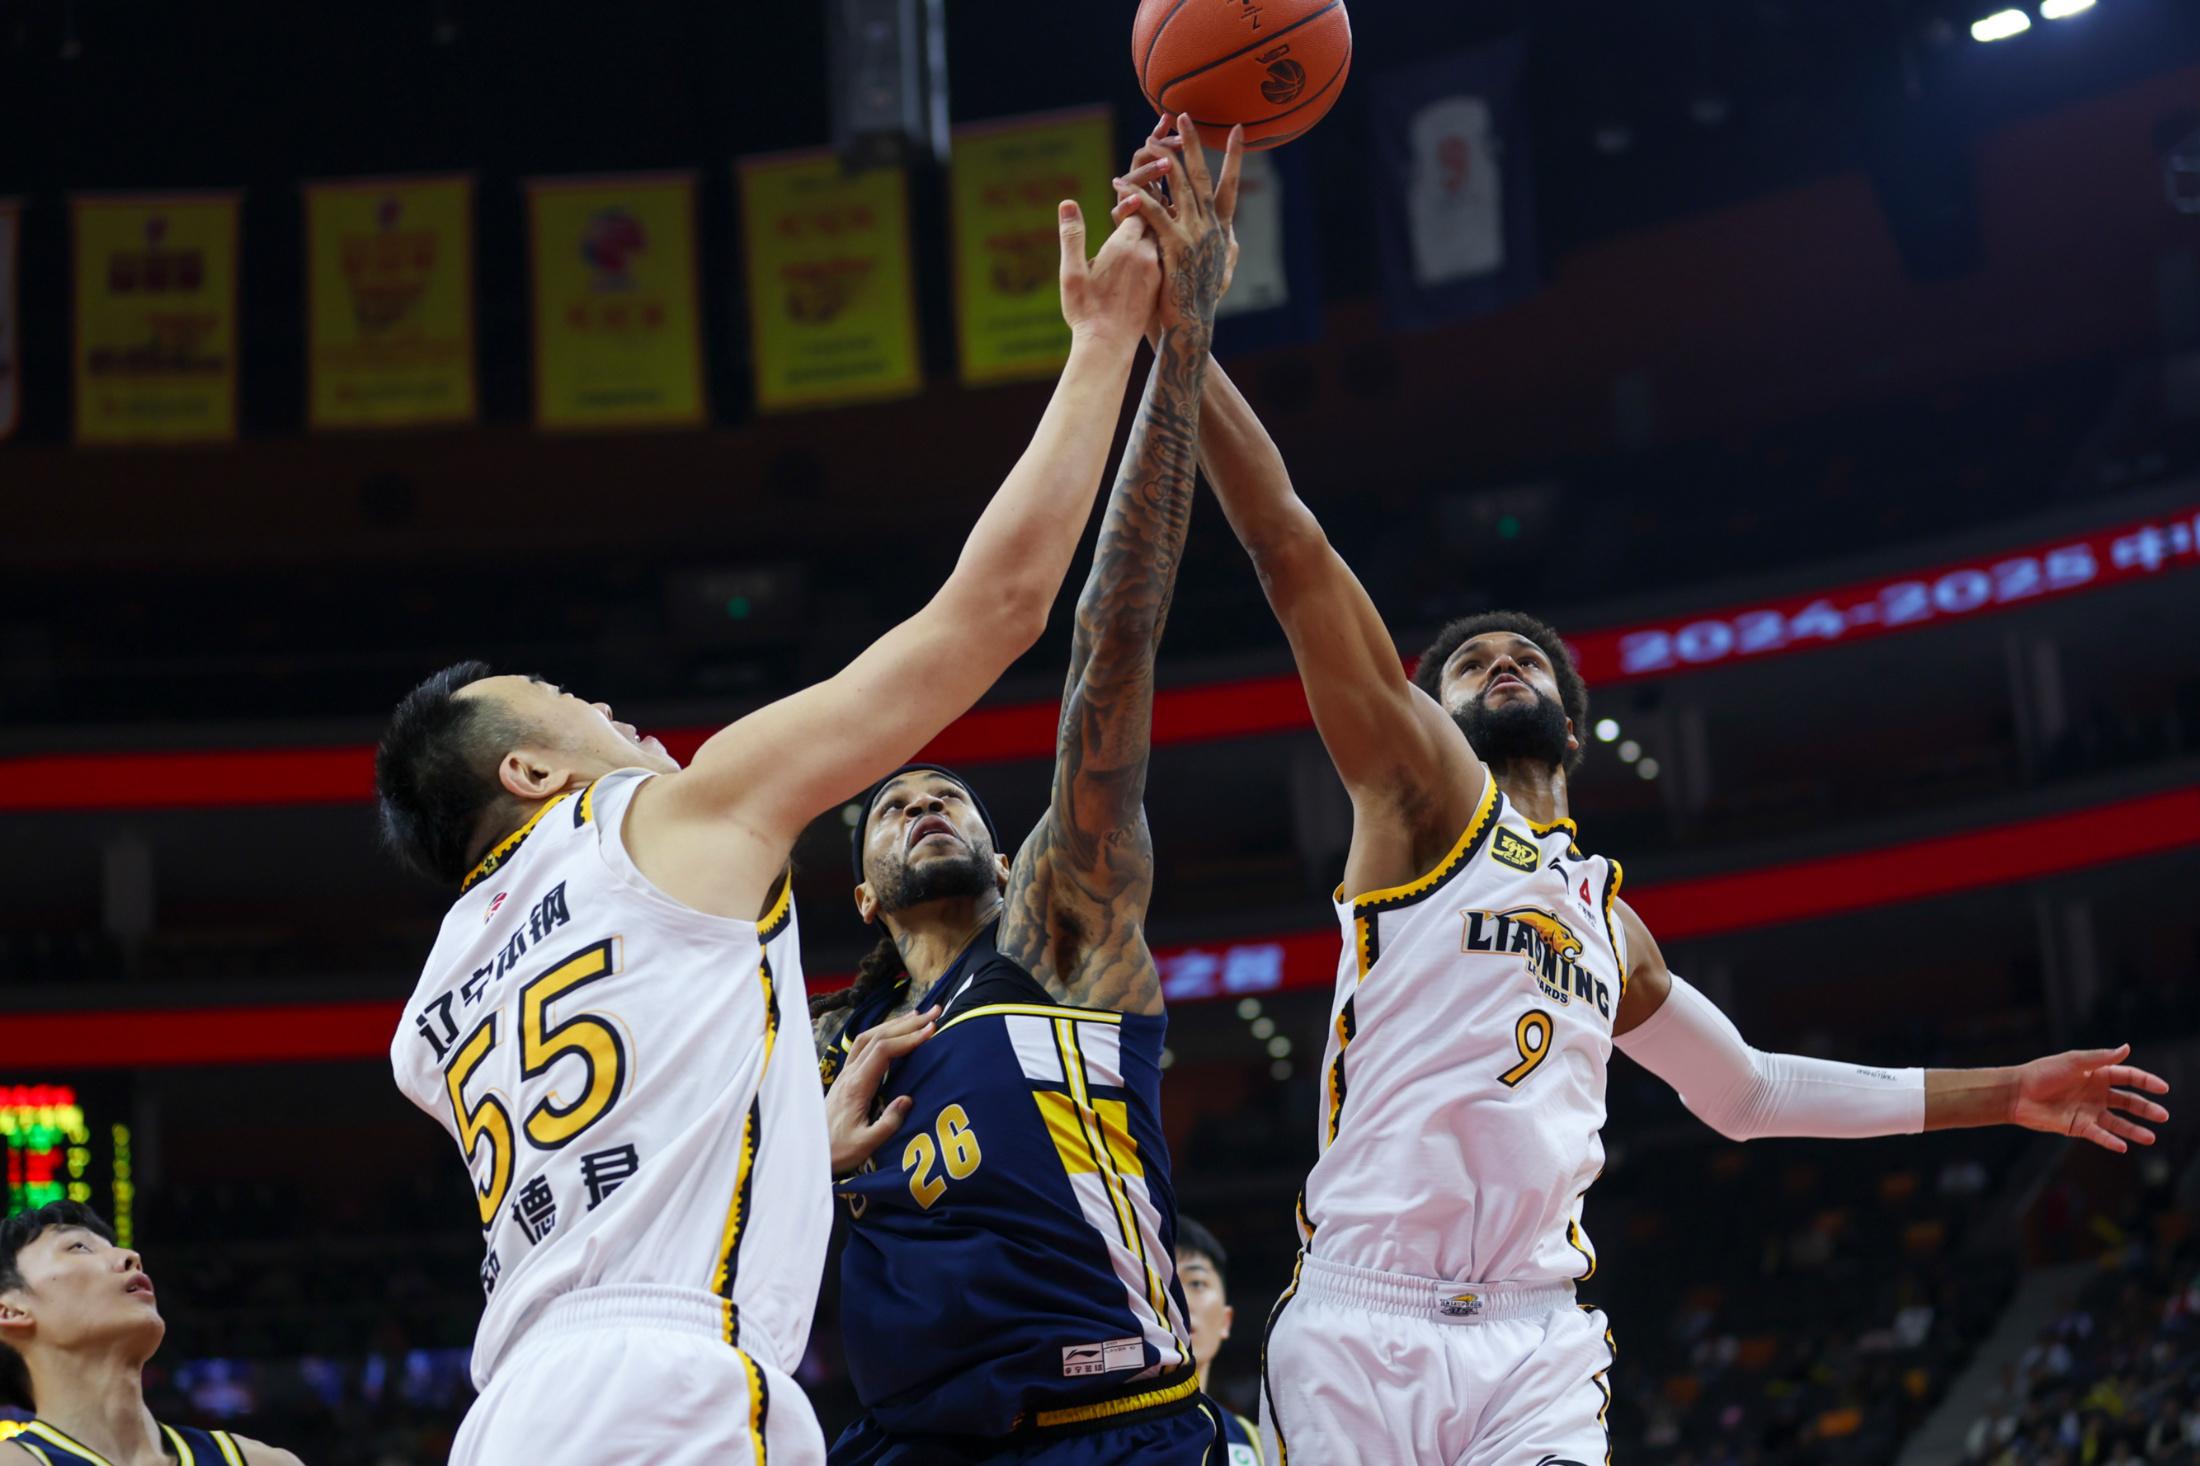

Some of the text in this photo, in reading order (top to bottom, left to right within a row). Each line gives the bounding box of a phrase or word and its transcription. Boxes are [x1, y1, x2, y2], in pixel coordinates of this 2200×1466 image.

[1619, 543, 2098, 674] 2024-2025
[445, 936, 627, 1233] 55
[1496, 1008, 1554, 1087] 9
[902, 1103, 981, 1210] 26
